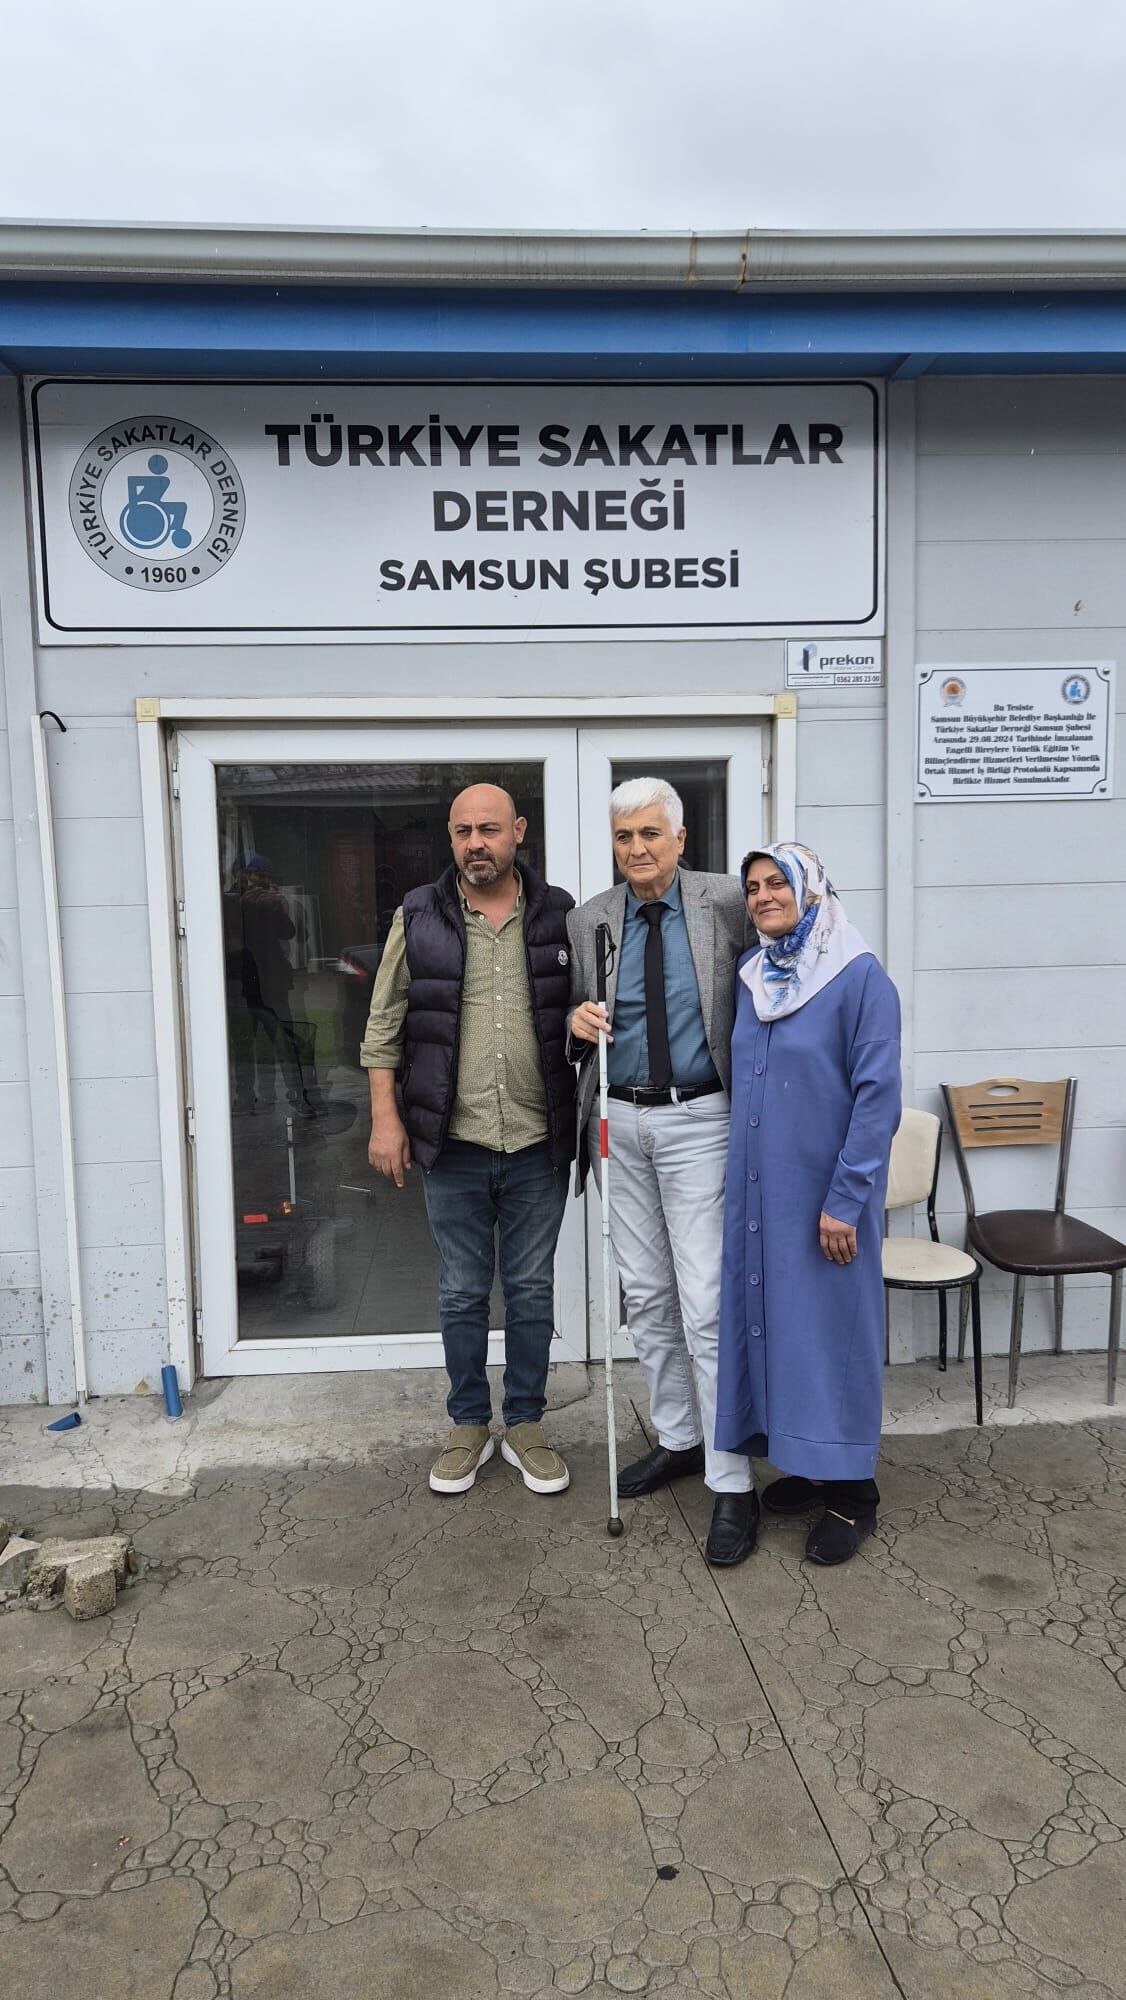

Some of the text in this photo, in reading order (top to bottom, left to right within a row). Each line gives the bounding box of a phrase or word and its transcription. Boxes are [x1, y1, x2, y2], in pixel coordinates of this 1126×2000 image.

[265, 414, 844, 467] TÜRKİYE SAKATLAR
[79, 424, 240, 563] TÜRKİYE SAKATLAR DERNEĞİ
[432, 478, 686, 532] DERNEĞİ
[141, 567, 187, 584] 1960
[379, 549, 740, 597] SAMSUN ŞUBESİ
[820, 654, 874, 670] prekon
[963, 715, 1007, 723] Büyükşehir
[1009, 714, 1041, 723] Belediye
[1044, 713, 1084, 722] Başkanlığı
[935, 726, 964, 734] Türkiye
[1066, 724, 1091, 732] Şubesi
[975, 746, 1009, 754] Bireylere
[1043, 744, 1069, 753] Eğitim
[924, 757, 981, 766] Bilinçlendirme
[1053, 765, 1100, 773] Kapsamında
